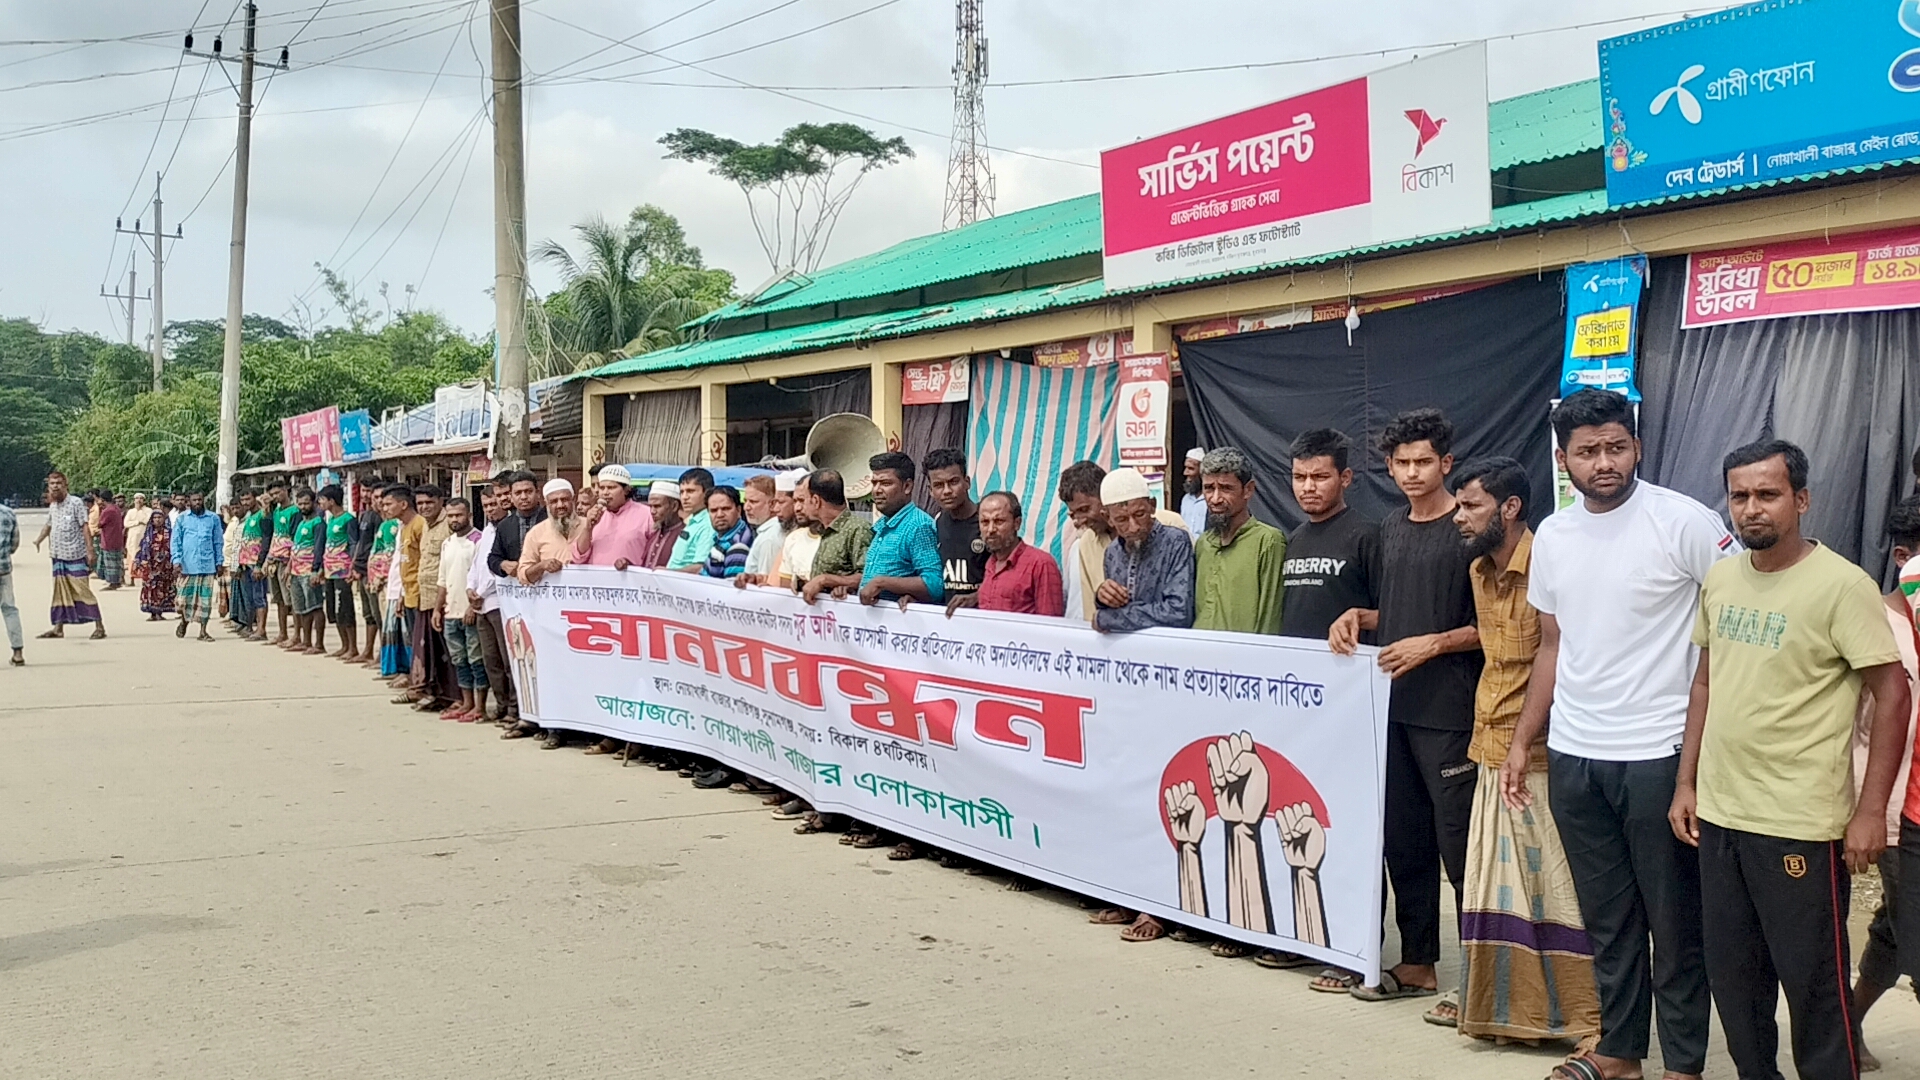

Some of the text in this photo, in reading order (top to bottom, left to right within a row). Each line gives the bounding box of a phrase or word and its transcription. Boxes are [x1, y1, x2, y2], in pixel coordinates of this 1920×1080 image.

[1705, 60, 1815, 101] গ্রামীণফোন
[1138, 113, 1315, 198] সার্ভিস পয়েন্ট
[1665, 167, 1693, 188] দেব
[1697, 152, 1745, 184] ট্রেডার্স
[1766, 145, 1818, 168] নোয়াখালী
[1859, 135, 1889, 154] মেইন
[1401, 161, 1454, 194] বিকাশ
[1170, 189, 1280, 226] এজেন্টভিত্তিক গ্রাহক সেবা
[1155, 247, 1175, 263] কবির
[1177, 240, 1214, 258] ডিজিটাল
[1241, 232, 1257, 246] এন্ড
[1698, 256, 1725, 269] ক্যাশ
[1867, 244, 1920, 260] চার্জ হাজ
[1697, 264, 1762, 297] সুবিধা
[1815, 259, 1853, 273] হাজার
[1695, 288, 1759, 316] ডাবল
[1126, 421, 1156, 438] নগদ
[1716, 604, 1787, 650] WAR
[809, 610, 839, 641] আলী
[853, 625, 889, 650] আসামী
[890, 632, 920, 656] করার
[921, 632, 965, 662] প্রতিবাদে
[965, 642, 987, 666] এবং
[989, 641, 1052, 673] অনতিবিলম্বে
[1053, 646, 1073, 679] এই
[1076, 653, 1111, 683] মামলা
[1115, 657, 1150, 688] থেকে
[1153, 662, 1179, 692] নাম
[1183, 666, 1262, 703] প্রত্যাহারের
[1266, 673, 1325, 709] দাবিতে
[561, 609, 1096, 769] মানববন্ধন
[828, 726, 869, 754] বিকাল
[701, 714, 778, 761] নোয়াখালী
[781, 745, 842, 787] বাজার
[854, 773, 1014, 840] এলাকাবাসী
[1790, 859, 1800, 870] B
